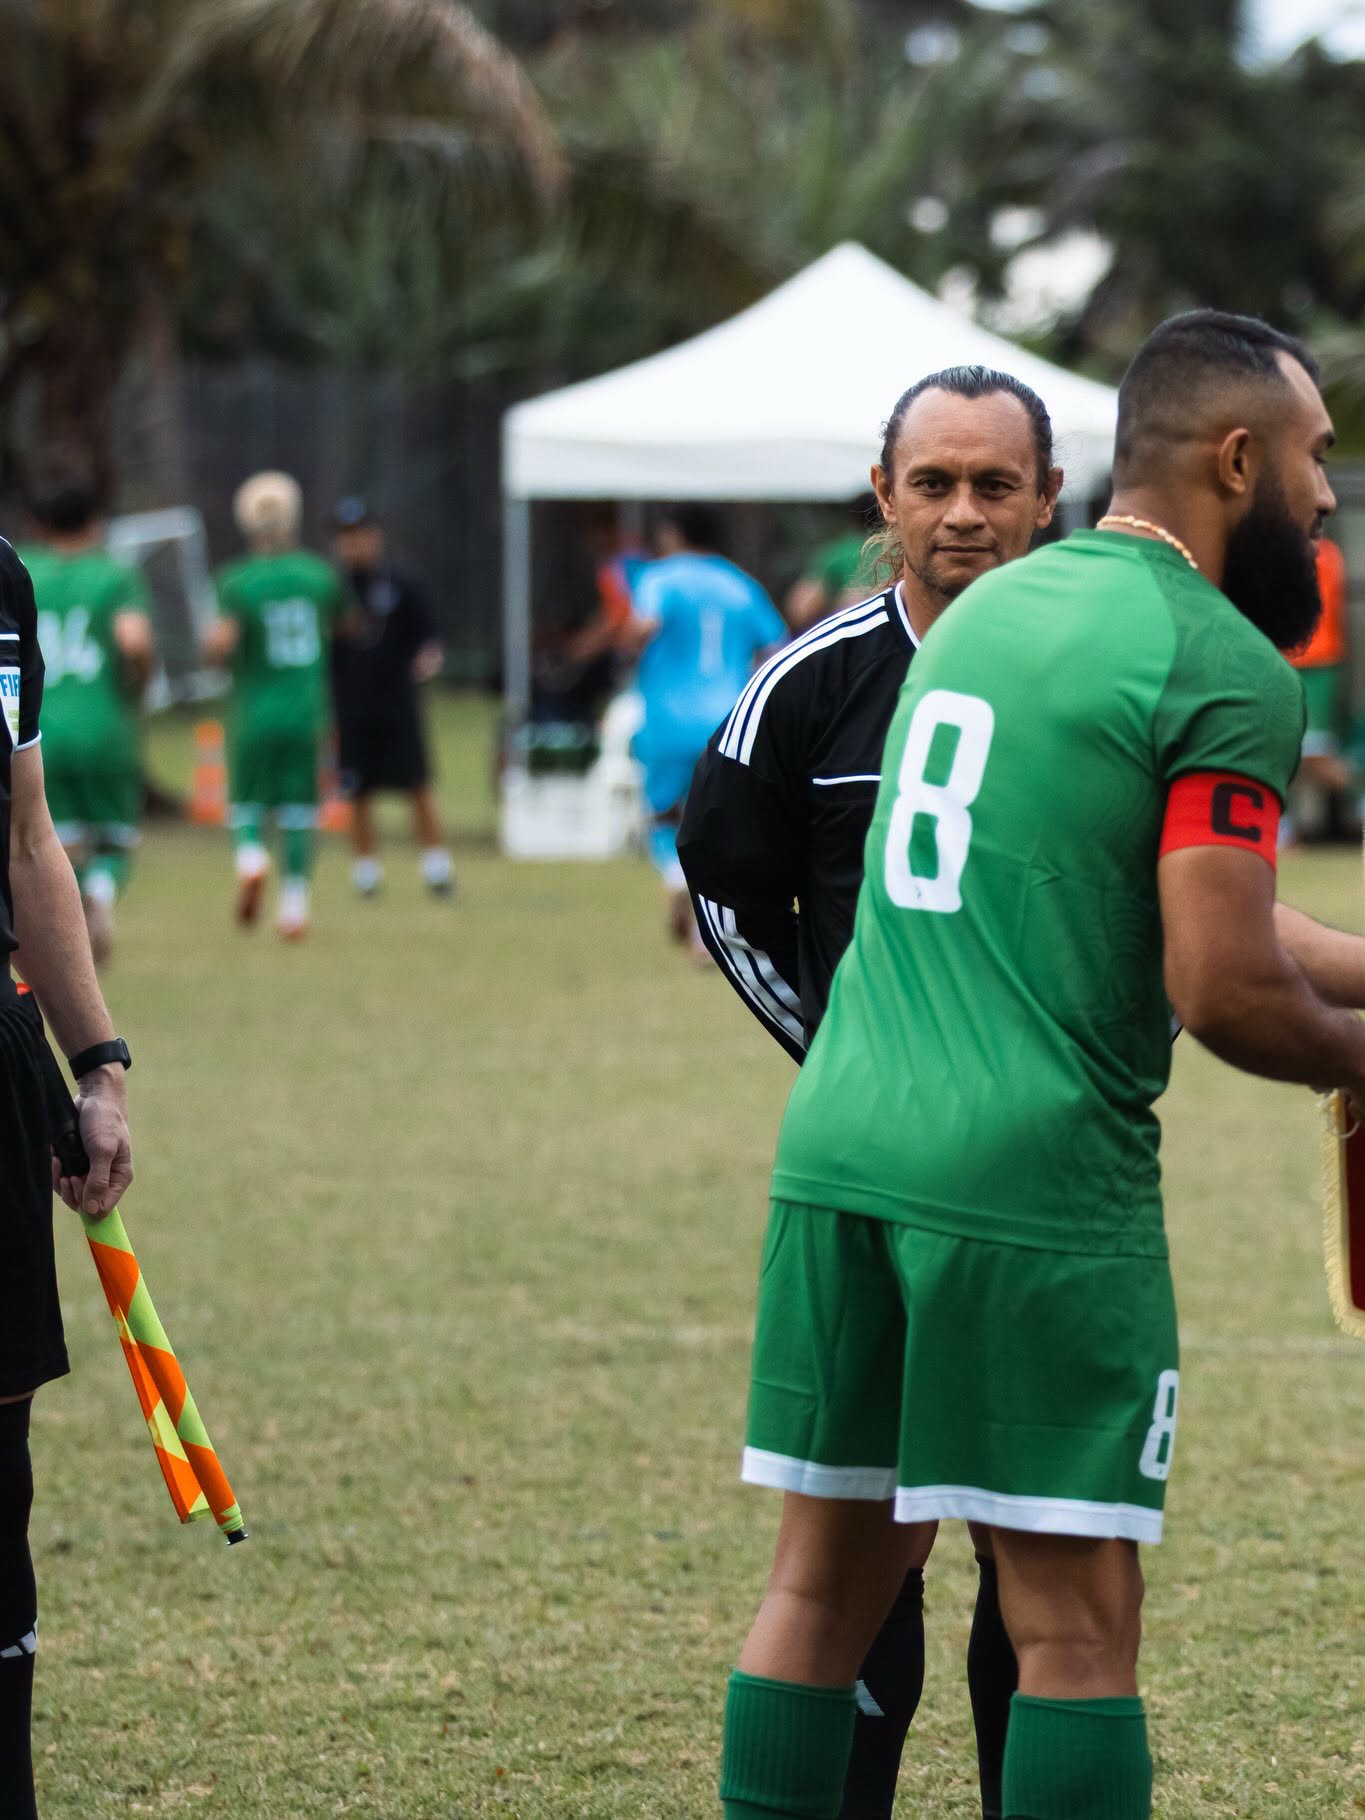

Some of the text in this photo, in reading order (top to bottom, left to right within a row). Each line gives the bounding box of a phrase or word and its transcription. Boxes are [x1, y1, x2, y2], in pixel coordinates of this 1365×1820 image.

[884, 688, 995, 914] 8
[1210, 783, 1275, 843] C
[1138, 1368, 1180, 1481] 8
